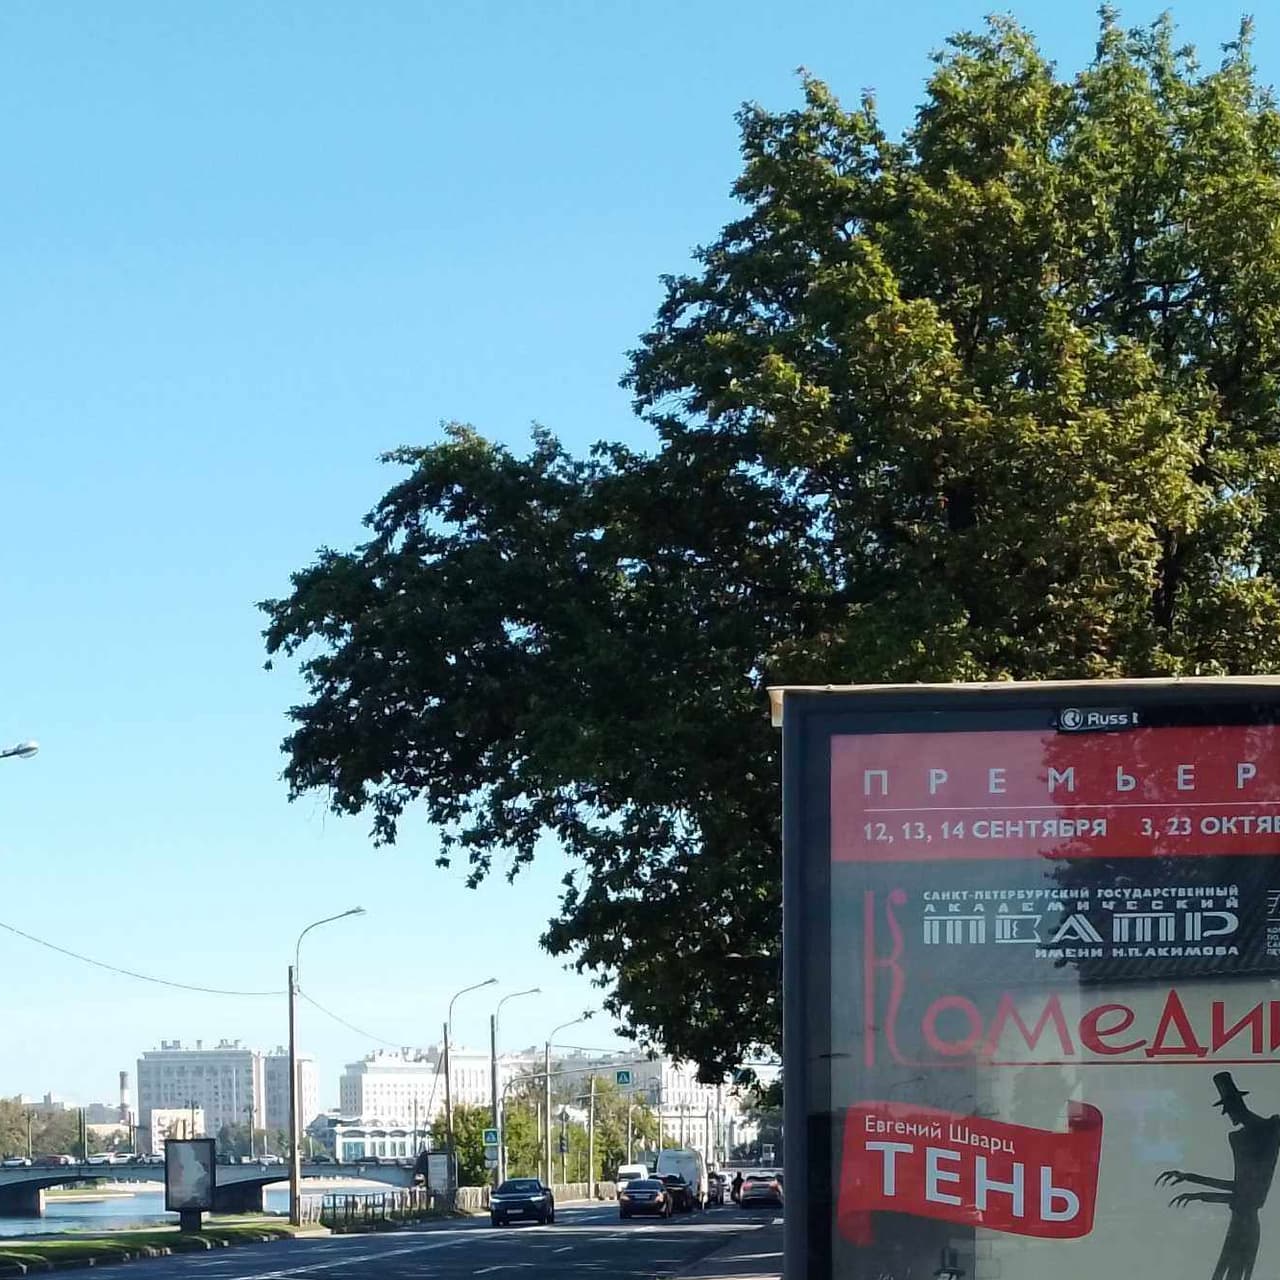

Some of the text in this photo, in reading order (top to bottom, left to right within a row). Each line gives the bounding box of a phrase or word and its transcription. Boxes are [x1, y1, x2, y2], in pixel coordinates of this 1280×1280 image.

[1087, 712, 1129, 725] Russ
[864, 822, 894, 843] 12,
[902, 821, 932, 842] 13,
[941, 821, 965, 840] 14
[972, 818, 1107, 839] СЕНТЯБРЯ
[1141, 817, 1160, 839] 3,
[1168, 817, 1192, 836] 23
[923, 885, 1239, 901] САНКТ-ПЕТЕРБУРГСКИЙ ГОСУДАРСТВЕННЫЙ
[924, 897, 1239, 913] АКАДЕМИЧЕСКИЙ
[1035, 948, 1104, 959] ИМЕНИ
[865, 1114, 1016, 1155] Евгений Шварц
[865, 1141, 1081, 1222] ТЕНЬ
